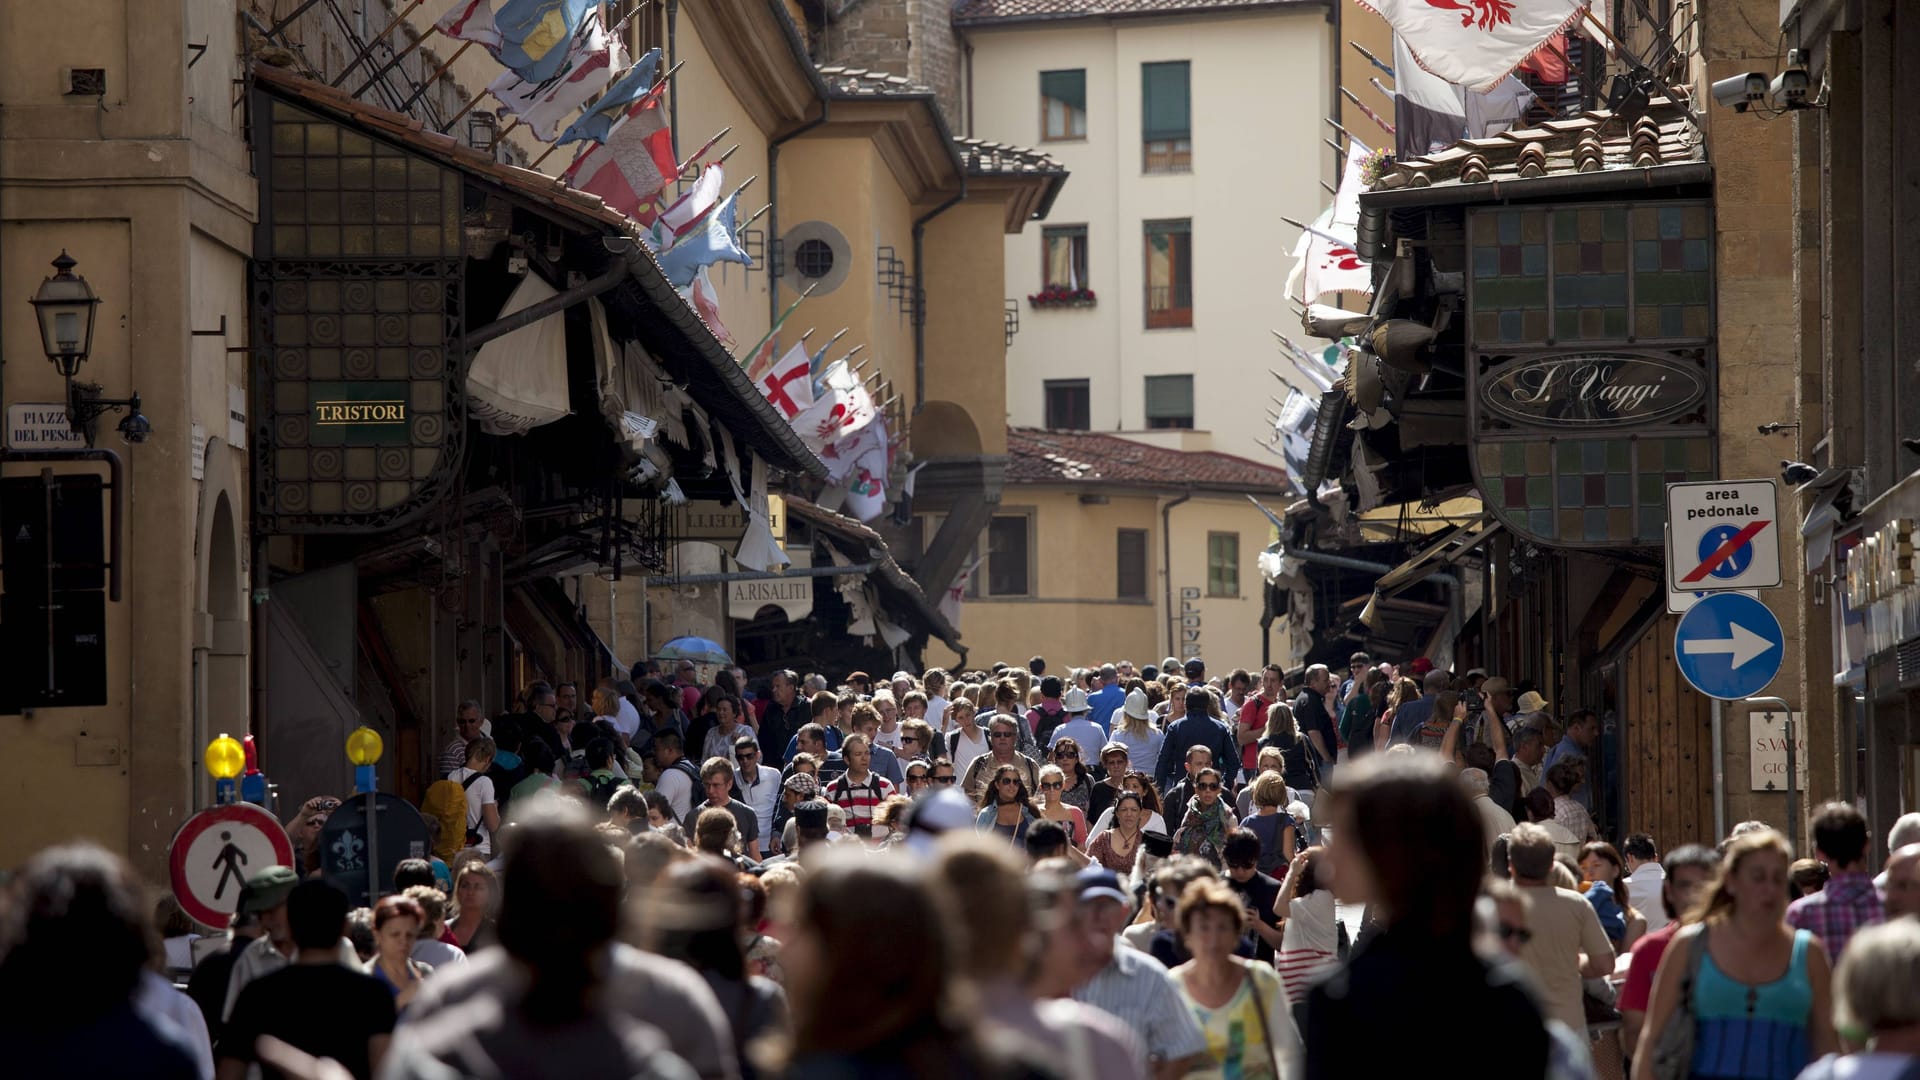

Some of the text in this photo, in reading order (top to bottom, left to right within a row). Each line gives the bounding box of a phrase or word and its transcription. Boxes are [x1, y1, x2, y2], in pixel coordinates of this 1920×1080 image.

[1569, 364, 1666, 412] Vaggi
[23, 411, 66, 424] PIAZZ
[316, 405, 405, 421] T.RISTORI
[14, 429, 39, 441] DEL
[1705, 490, 1739, 500] area
[1687, 504, 1759, 520] pedonale
[734, 583, 807, 601] A.RISALITI
